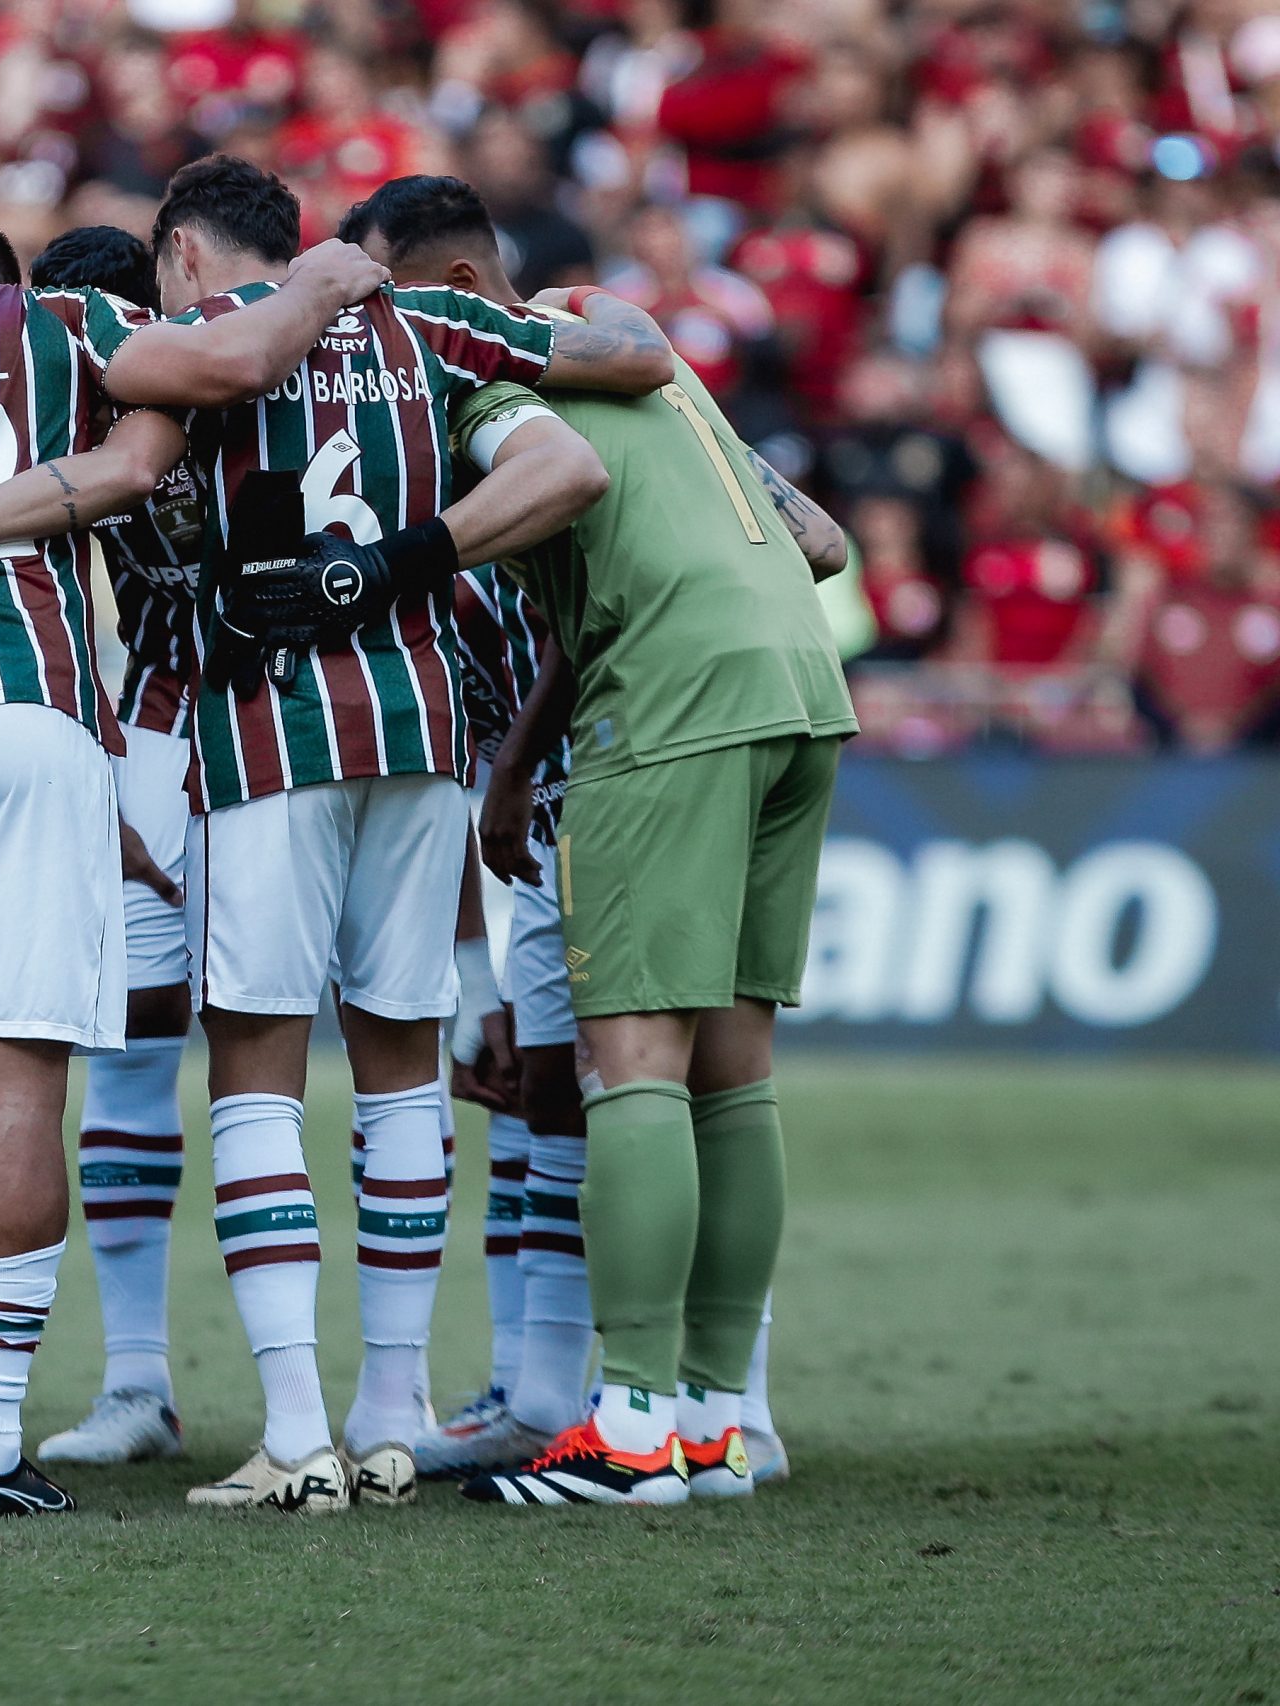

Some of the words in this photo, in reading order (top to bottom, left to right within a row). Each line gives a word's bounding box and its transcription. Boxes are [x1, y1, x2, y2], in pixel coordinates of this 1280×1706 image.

[313, 366, 433, 405] BARBOSA
[300, 427, 383, 547] 6
[660, 381, 767, 545] 1
